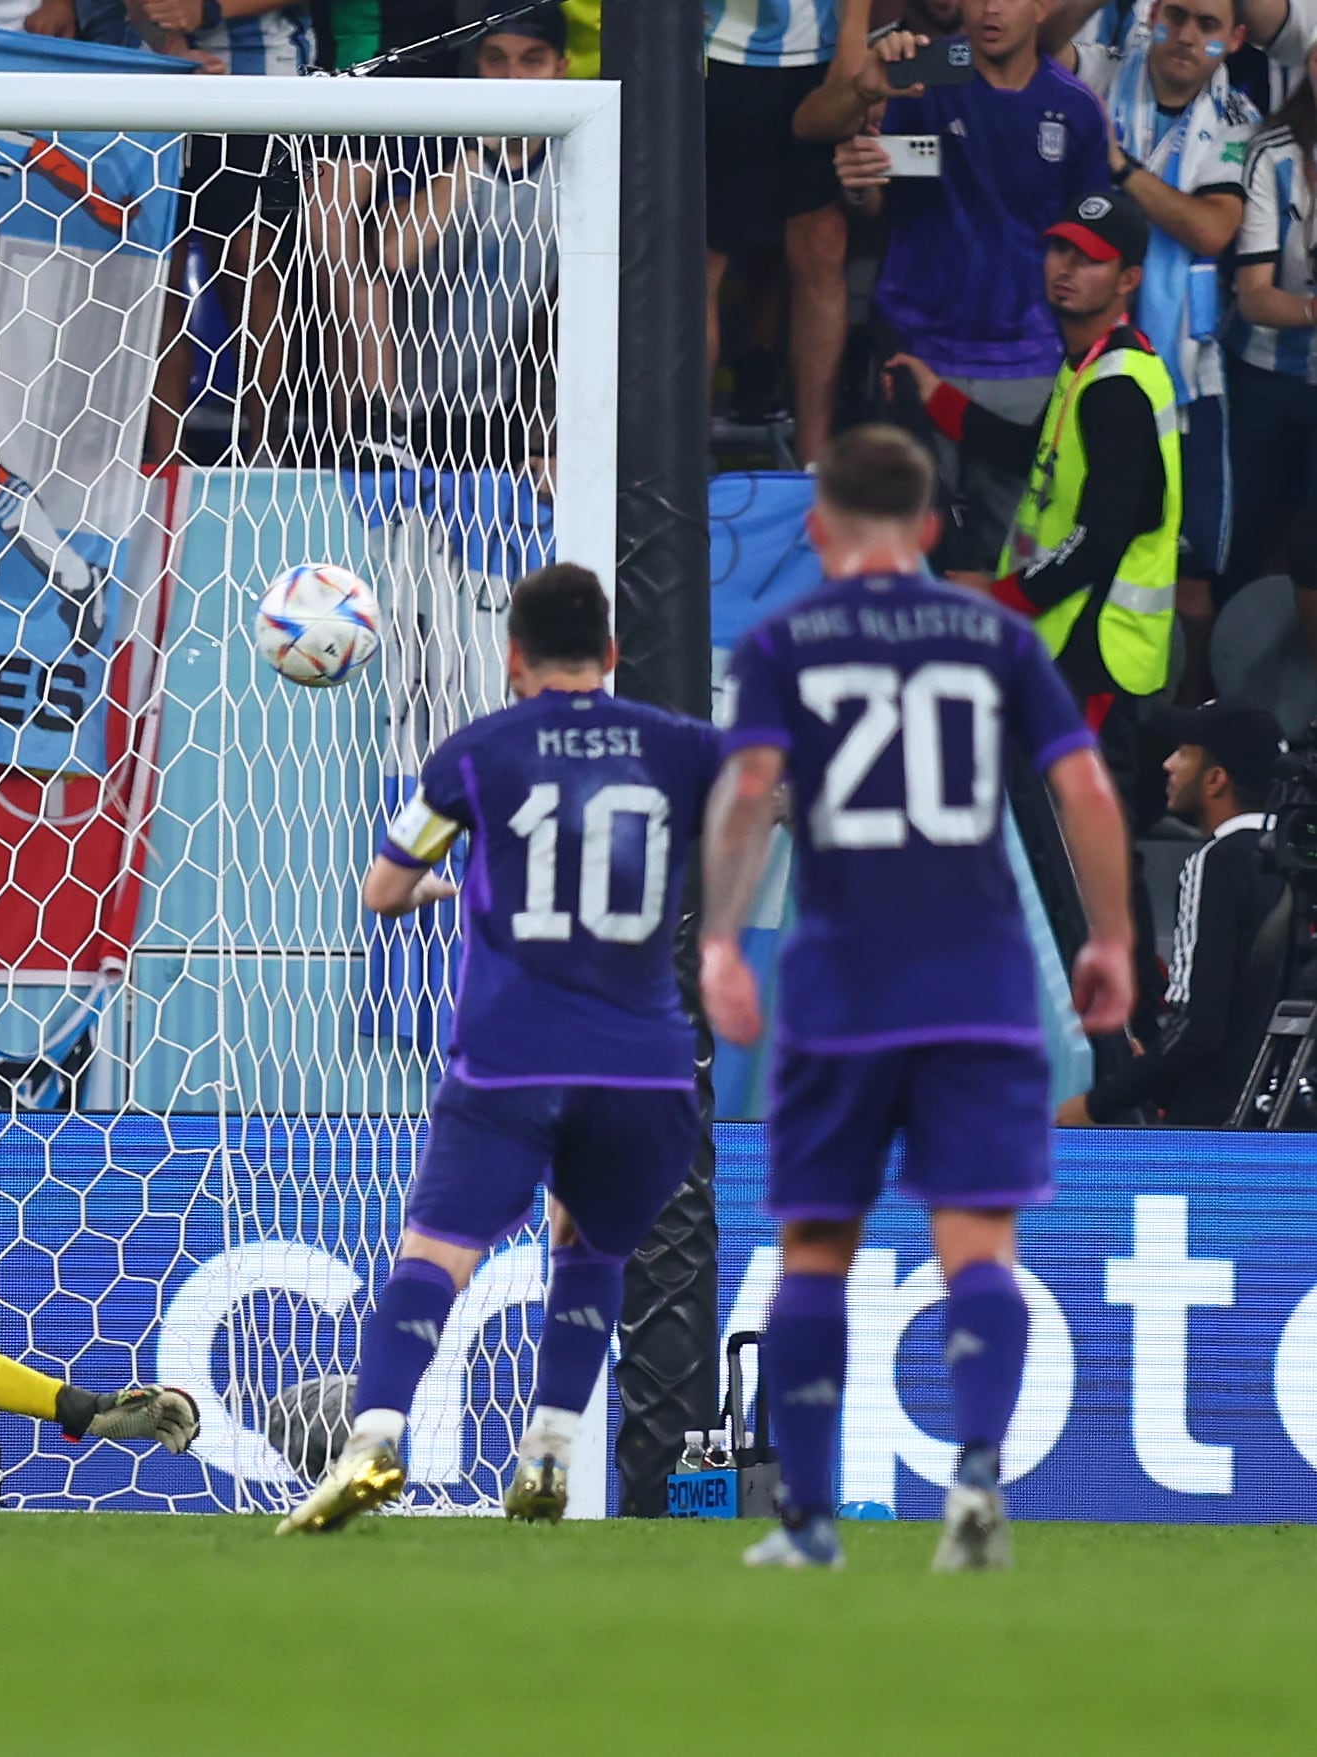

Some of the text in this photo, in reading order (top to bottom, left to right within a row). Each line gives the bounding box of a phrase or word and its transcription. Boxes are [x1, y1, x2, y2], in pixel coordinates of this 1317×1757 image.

[536, 726, 642, 760] MESSI
[797, 662, 1002, 850] 20
[507, 782, 672, 944] 10
[667, 1478, 728, 1511] POWER
